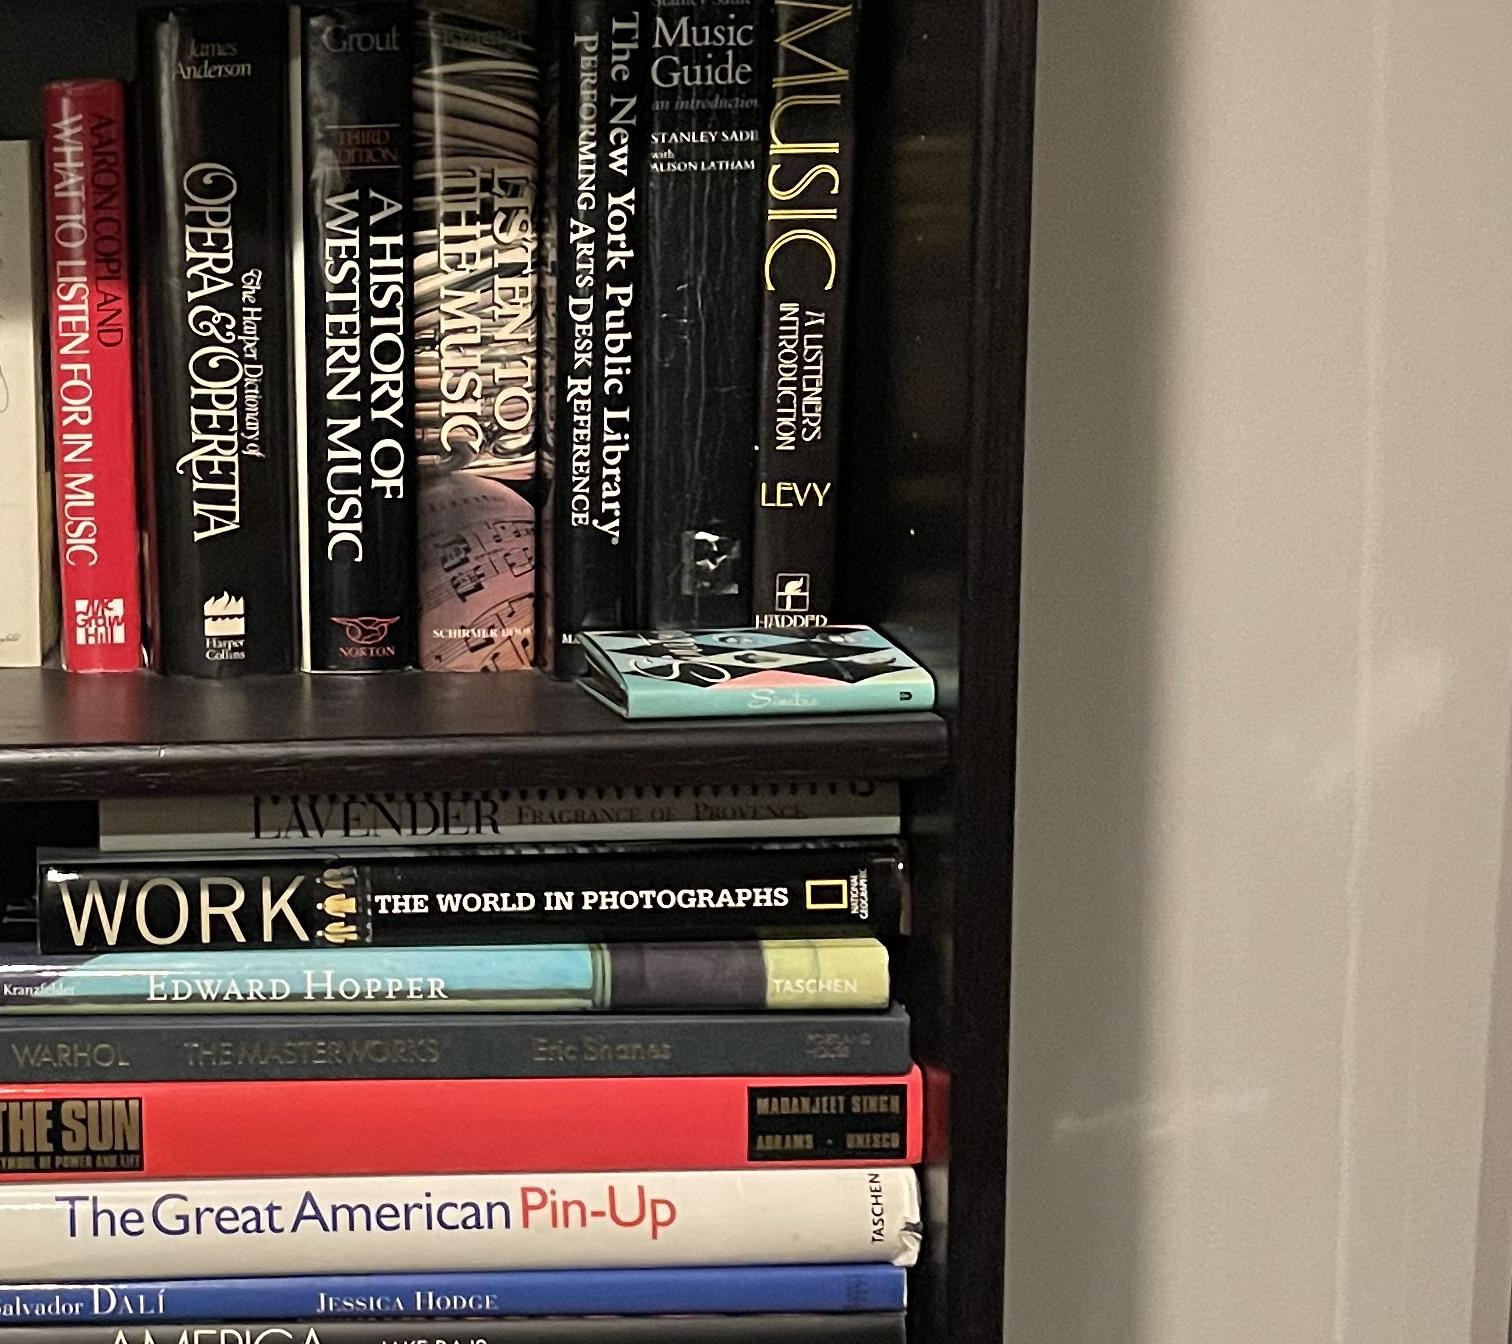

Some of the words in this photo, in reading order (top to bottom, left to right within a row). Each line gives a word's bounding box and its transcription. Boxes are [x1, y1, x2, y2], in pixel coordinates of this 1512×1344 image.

[611, 11, 639, 82] The
[651, 14, 754, 48] Music
[651, 50, 753, 88] Guide
[52, 113, 86, 202] WHAT
[609, 95, 637, 177] New
[765, 0, 852, 291] MUSIC
[55, 210, 88, 249] TO
[369, 187, 403, 226] A
[606, 188, 636, 272] York
[56, 260, 90, 355] LISTEN
[324, 190, 361, 402] WESTERN
[370, 235, 405, 429] HISTORY
[604, 283, 633, 395] Public
[60, 362, 93, 427] FOR
[62, 433, 94, 463] IN
[370, 438, 405, 499] OF
[593, 406, 631, 540] Library
[64, 473, 98, 566] MUSIC
[326, 416, 363, 562] MUSIC
[760, 482, 831, 507] LEVY
[57, 874, 311, 947] WORK
[375, 894, 429, 915] THE
[437, 892, 535, 914] WORLD
[544, 891, 574, 911] IN
[581, 887, 789, 911] PHOTOGRAPHS
[147, 974, 290, 1002] EDWARD
[302, 970, 449, 1002] HOPPER
[774, 979, 858, 994] TASCHEN
[12, 1043, 130, 1068] WARHOL
[60, 1099, 141, 1153] SUN
[54, 1194, 145, 1238] The
[152, 1192, 286, 1236] Great
[290, 1190, 511, 1233] American
[520, 1184, 677, 1240] Pin-Up
[868, 1172, 885, 1244] TASCHEN
[316, 1291, 404, 1314] JESSICA
[415, 1290, 499, 1311] HODGE
